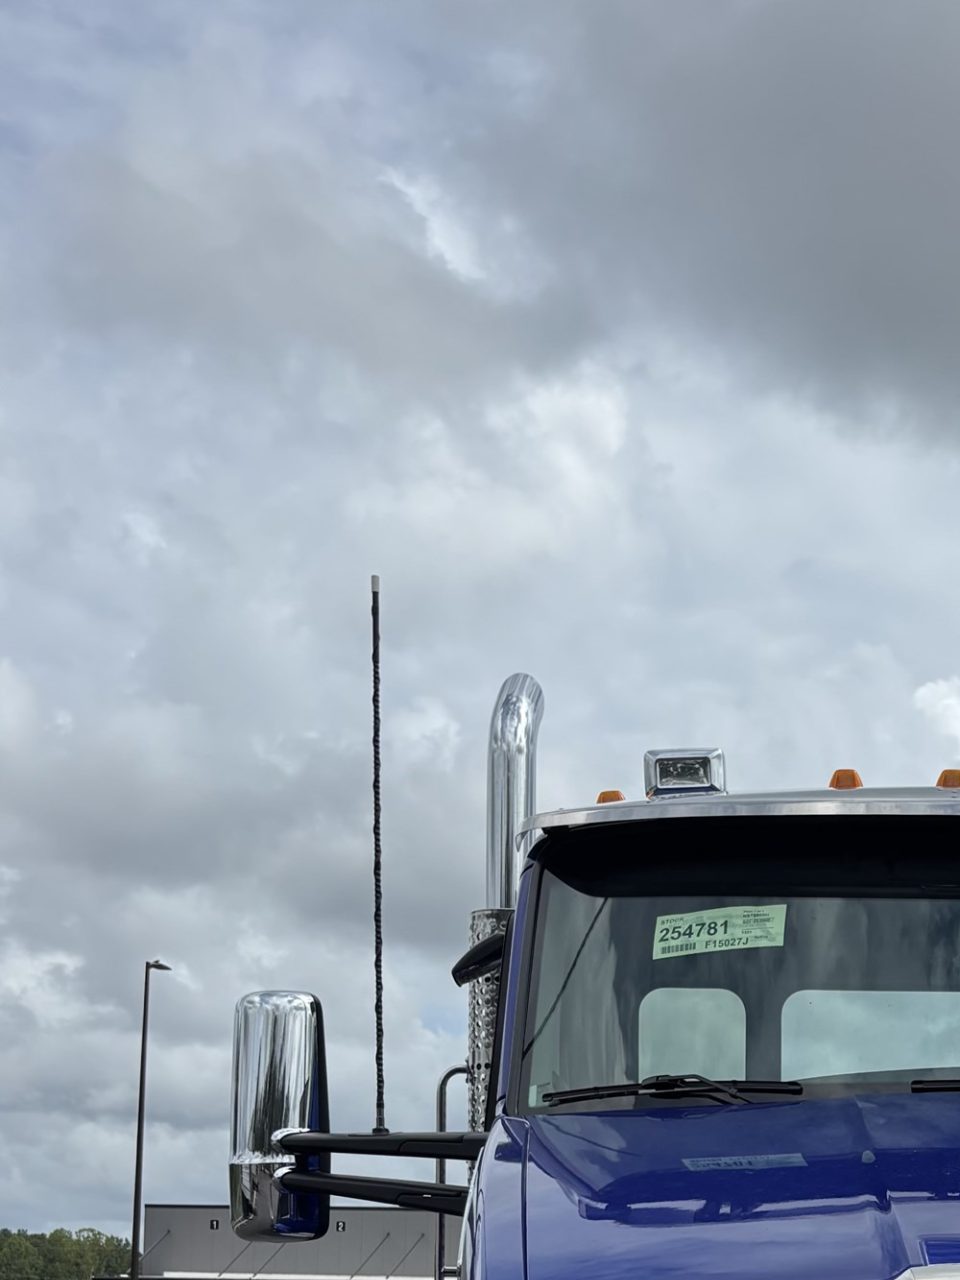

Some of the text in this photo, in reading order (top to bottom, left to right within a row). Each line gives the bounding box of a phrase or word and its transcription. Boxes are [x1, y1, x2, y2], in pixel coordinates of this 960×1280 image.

[661, 917, 684, 925] STOCK
[658, 919, 729, 943] 254781
[705, 938, 749, 949] F15027J
[338, 1222, 344, 1231] 2
